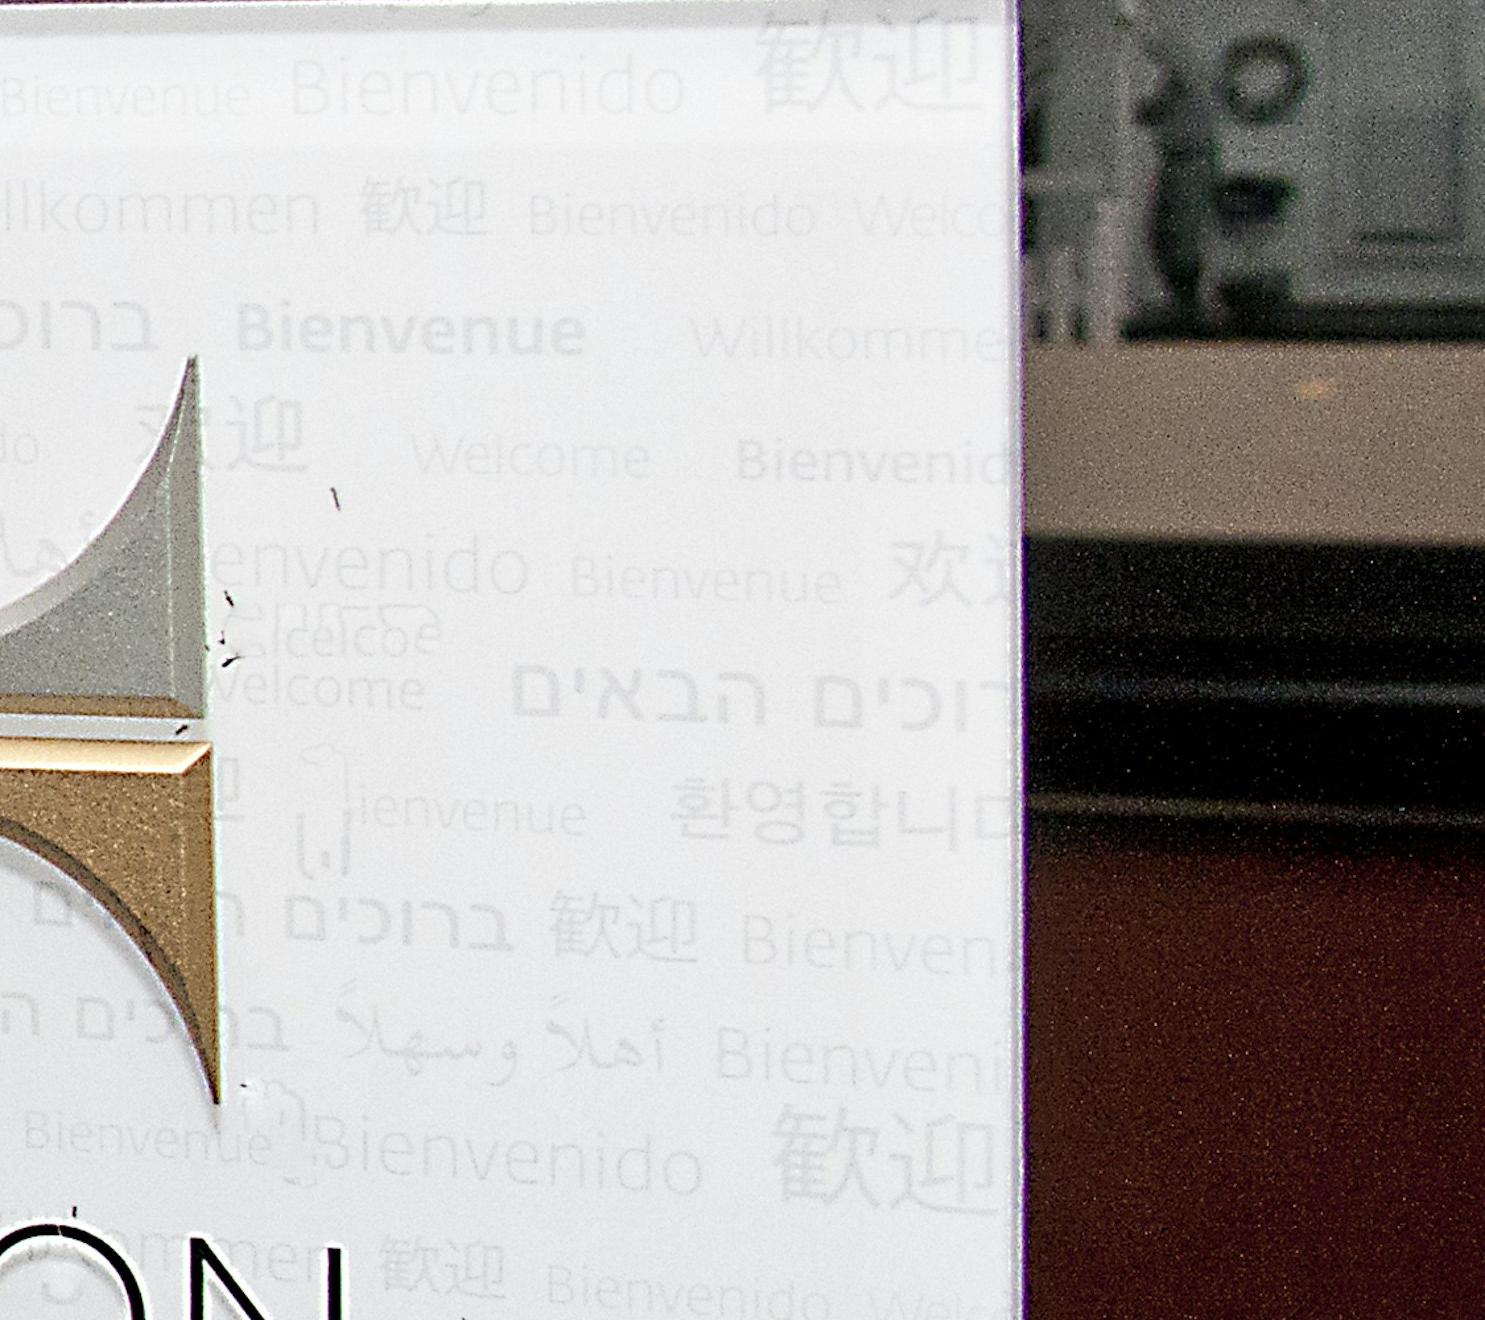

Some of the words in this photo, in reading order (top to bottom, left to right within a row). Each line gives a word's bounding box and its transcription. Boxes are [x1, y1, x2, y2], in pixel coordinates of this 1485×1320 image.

[0, 73, 252, 119] Bienvenue
[290, 54, 687, 118] Bienvenido
[529, 193, 818, 240] Bienvenido
[235, 299, 588, 358] Bienvenue
[410, 431, 651, 480] Welcome
[571, 554, 844, 607] Bienvenue
[770, 1101, 999, 1218] 歡迎
